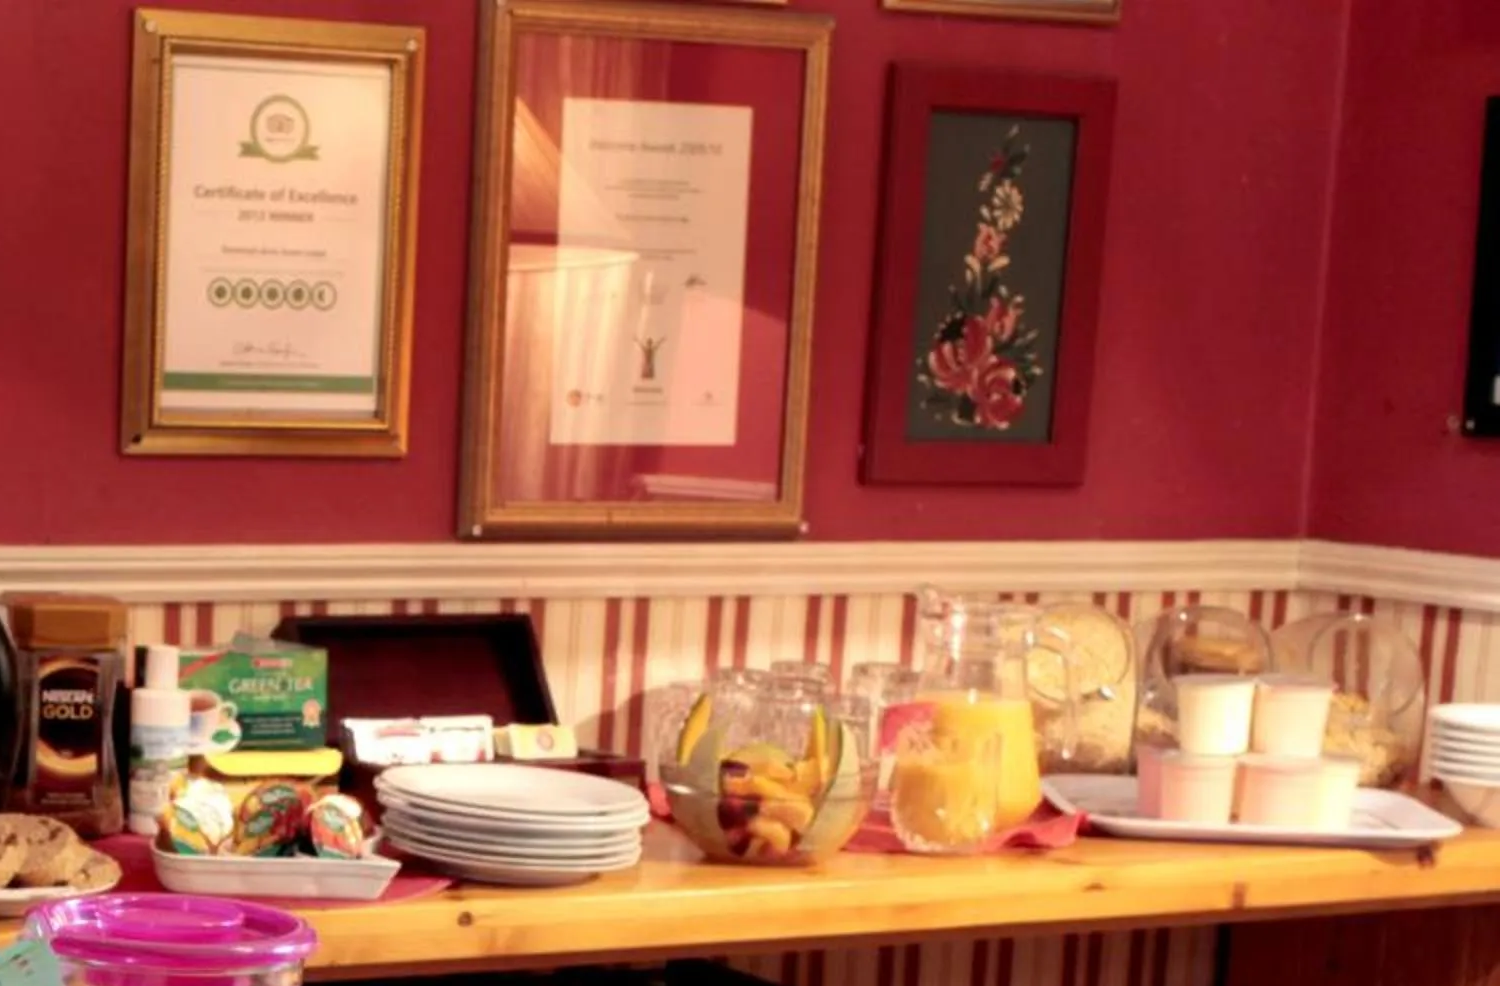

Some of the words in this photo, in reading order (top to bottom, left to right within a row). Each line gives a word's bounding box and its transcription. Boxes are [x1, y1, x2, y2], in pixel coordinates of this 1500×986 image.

[193, 184, 266, 202] Certificate
[268, 186, 286, 202] of
[287, 187, 358, 206] Excellence
[43, 704, 94, 719] GOLD
